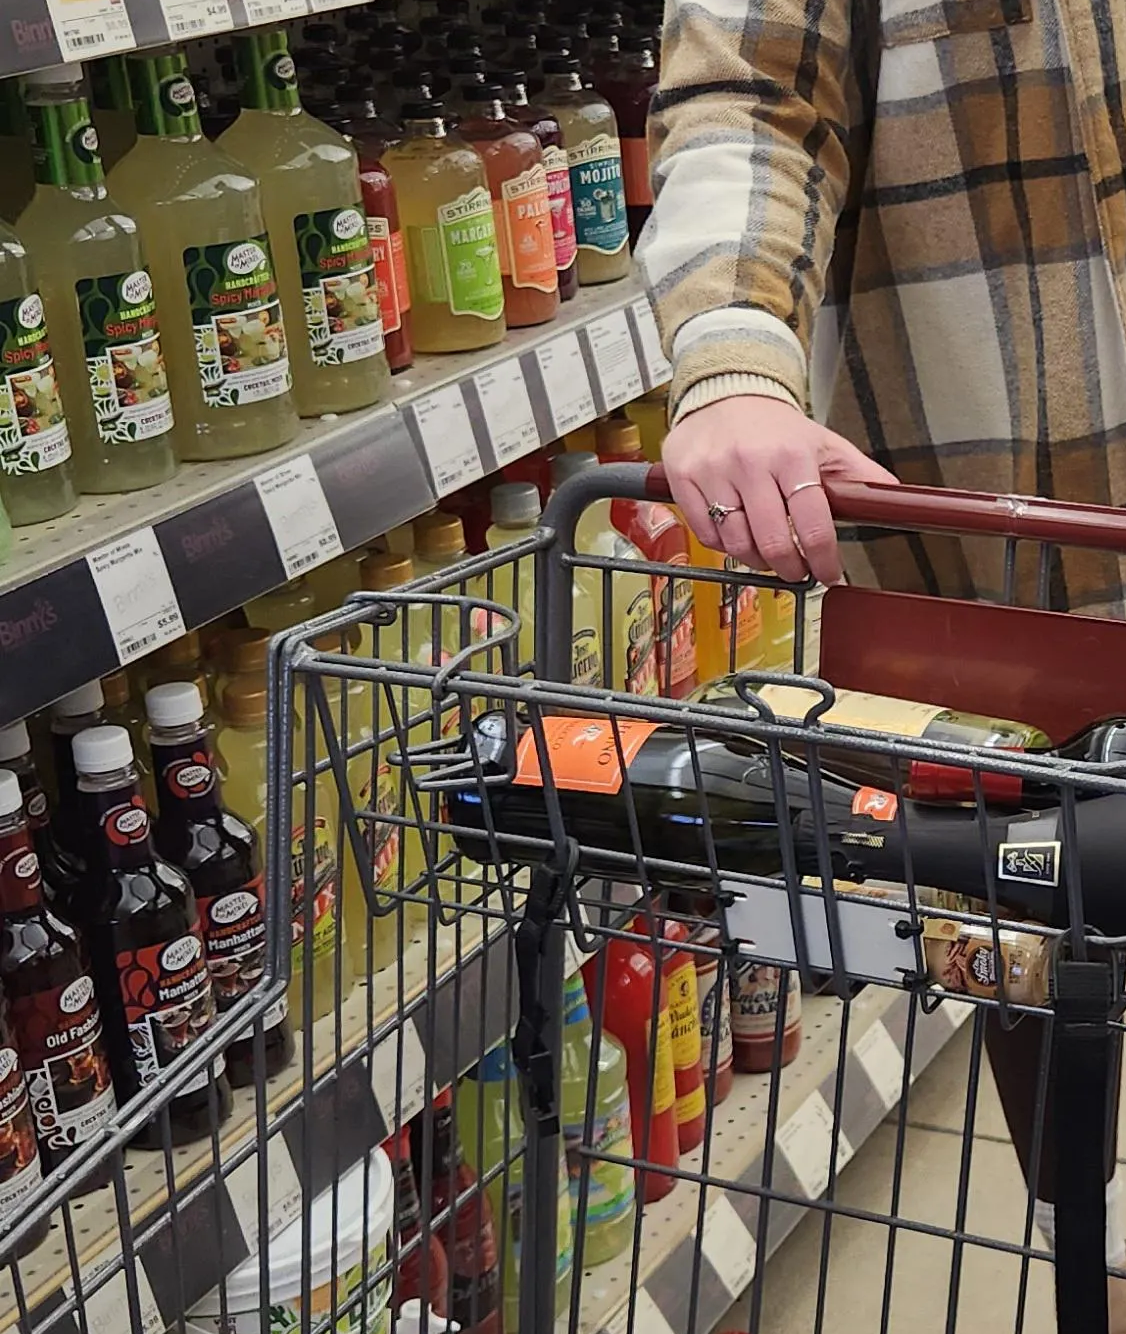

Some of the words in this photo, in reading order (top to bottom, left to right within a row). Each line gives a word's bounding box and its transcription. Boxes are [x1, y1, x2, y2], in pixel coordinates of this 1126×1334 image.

[211, 290, 242, 308] Spicy
[105, 320, 137, 338] Spicy
[3, 346, 35, 365] Spicy
[215, 893, 247, 918] MASTER
[208, 923, 266, 951] Manhattan
[166, 938, 194, 966] MASTER
[64, 979, 89, 1008] MASTER
[46, 1031, 69, 1050] Old
